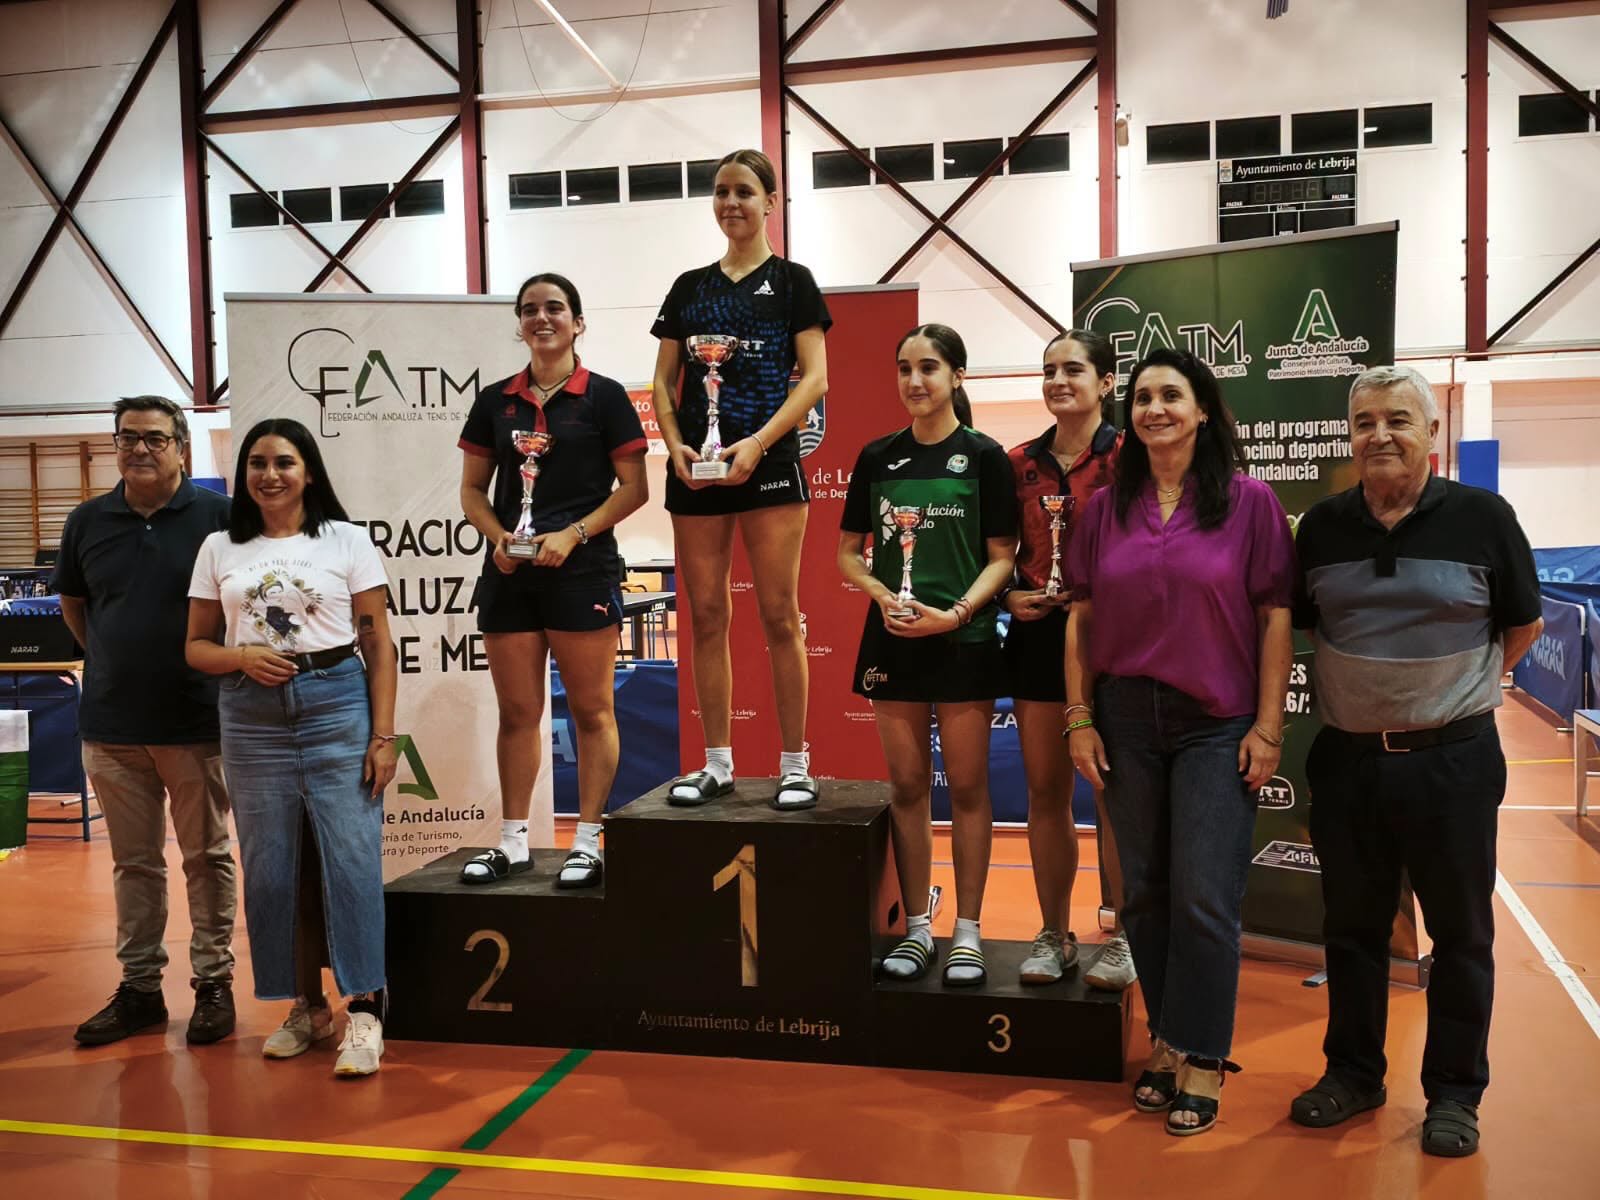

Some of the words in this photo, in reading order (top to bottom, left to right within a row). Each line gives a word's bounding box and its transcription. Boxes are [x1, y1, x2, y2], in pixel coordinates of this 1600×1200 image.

[1236, 162, 1302, 179] Ayuntamiento
[1305, 159, 1316, 170] de
[1319, 156, 1356, 171] Lebrija
[1267, 346, 1298, 357] Junta
[1301, 343, 1314, 354] de
[1316, 337, 1367, 353] Andalucía
[1228, 366, 1246, 376] MESA
[1269, 370, 1306, 378] Patrimonio
[1339, 365, 1365, 375] Deporte
[327, 411, 378, 421] FEDERACIÓN
[382, 412, 423, 421] ANDALUZA
[427, 412, 447, 421] TENIS
[450, 412, 461, 421] DE
[1254, 420, 1276, 440] del
[1279, 419, 1349, 440] programa
[1243, 440, 1285, 460] ocinio
[812, 466, 832, 485] de
[1248, 460, 1319, 481] Andalucía
[760, 480, 790, 492] NARAQ
[815, 488, 828, 499] de
[990, 713, 1018, 729] ZA
[400, 804, 486, 824] Andalucía
[401, 832, 415, 842] de
[417, 830, 463, 841] Turismo,
[399, 848, 406, 858] y
[407, 844, 450, 856] Deporte
[712, 843, 760, 988] 1
[464, 929, 513, 1012] 2
[637, 1010, 750, 1031] Ayuntamiento
[755, 1015, 775, 1032] de
[779, 1017, 841, 1041] Lebrija
[987, 1013, 1012, 1053] 3
